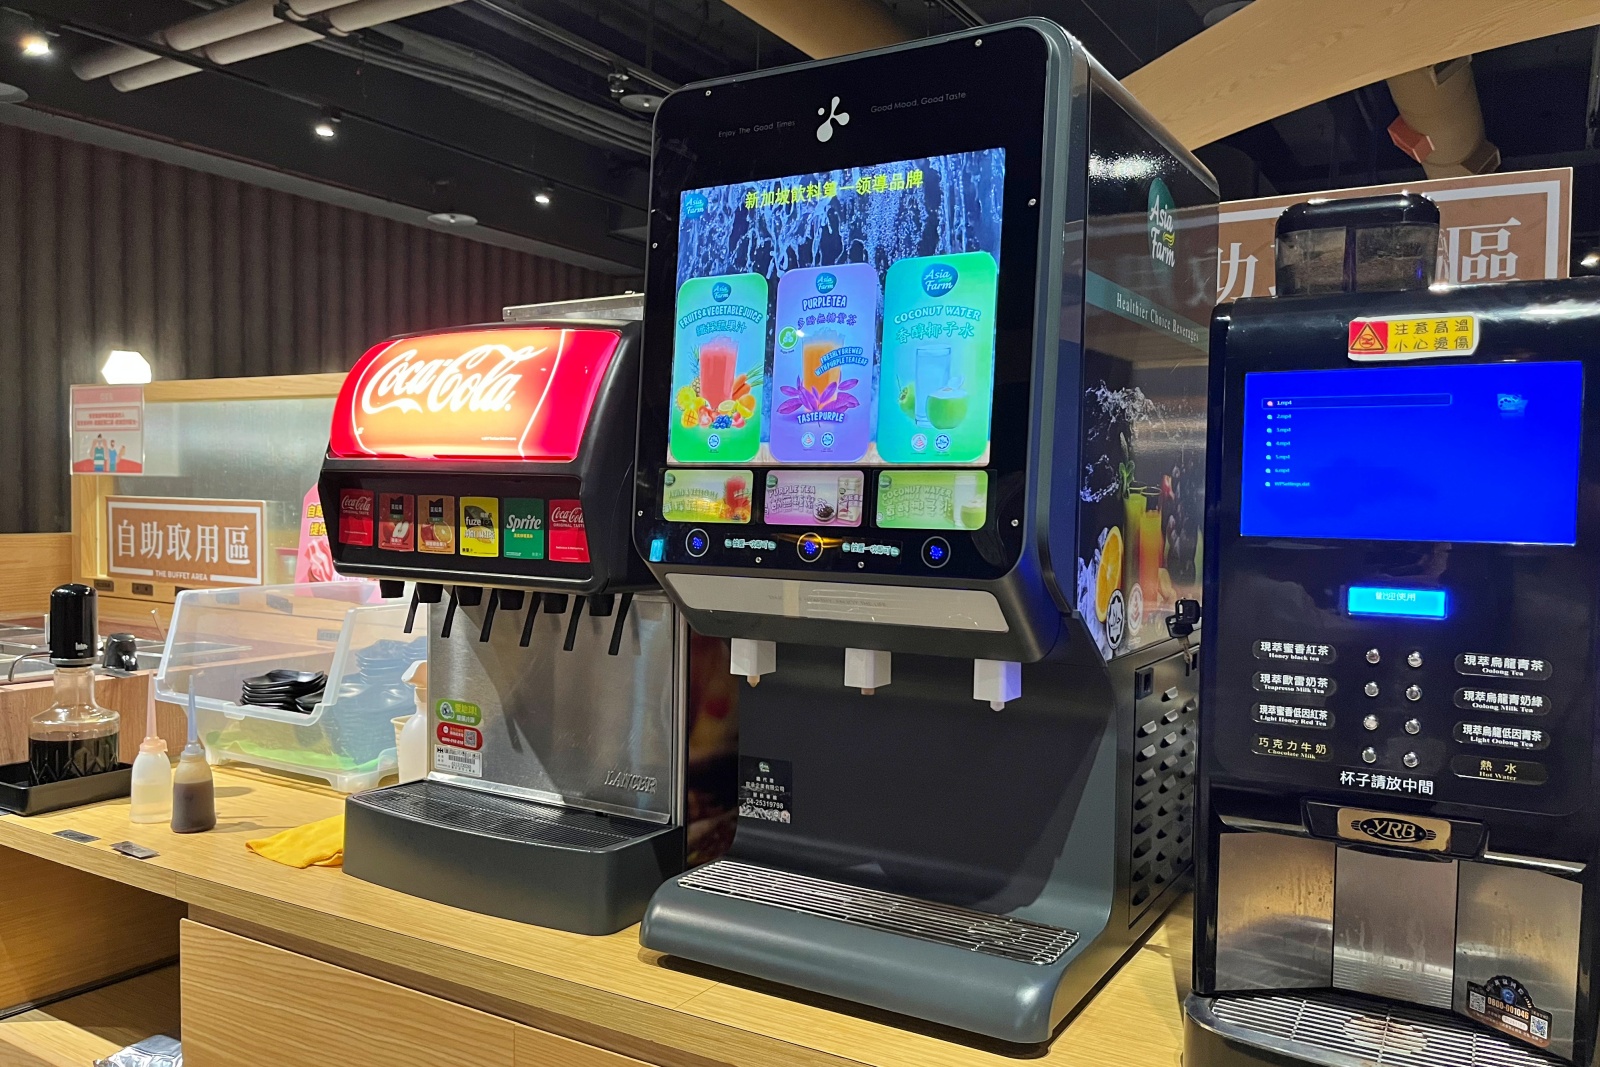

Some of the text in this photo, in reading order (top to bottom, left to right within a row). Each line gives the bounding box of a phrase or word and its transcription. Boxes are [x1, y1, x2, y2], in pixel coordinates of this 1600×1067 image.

[870, 102, 892, 113] Good
[921, 95, 944, 105] Good
[945, 92, 966, 100] Taste
[718, 130, 736, 138] Enjoy
[753, 123, 774, 132] Good
[776, 120, 795, 129] Times
[686, 198, 703, 206] Asia
[687, 206, 704, 214] Farm
[1150, 194, 1174, 232] Asia
[1151, 227, 1175, 267] Farm
[924, 268, 950, 280] Asia
[925, 280, 953, 292] Farm
[802, 295, 847, 311] PURPLE TEA
[680, 309, 702, 329] FRUITS
[707, 305, 744, 317] VEGETABLE
[743, 307, 763, 323] JUICE
[894, 305, 981, 325] COCONUT WATER
[1116, 292, 1199, 343] Healthier Choice Beverages
[1395, 319, 1469, 335] 注意高溫
[1394, 336, 1469, 352] 小心燙傷
[820, 347, 863, 363] FRESHLY BREWED
[362, 344, 548, 415] Coca-Cola
[797, 411, 845, 424] TASTE PURPLE
[769, 485, 816, 498] PURPLE TEA
[882, 486, 952, 501] COCONUT WATER
[342, 495, 372, 512] Coca-Cola
[466, 516, 481, 526] fuze
[506, 514, 541, 532] Sprite
[118, 519, 250, 564] 自助取用區
[168, 571, 190, 580] BUFFET
[1260, 641, 1329, 656] 現萃蜜香紅茶
[1464, 655, 1544, 672] 現萃烏龍青茶
[1482, 668, 1509, 676] Oolong
[1463, 690, 1543, 708] 現萃烏龍青奶綠
[1472, 703, 1499, 711] Oolong
[1259, 704, 1328, 721] 現萃蜜香低因紅茶
[1278, 716, 1299, 724] Honey
[1463, 724, 1542, 742] 現萃烏龍低因青茶
[1470, 736, 1490, 744] Light
[1492, 738, 1518, 747] Oolong
[1259, 738, 1327, 755] 巧克力牛奶
[1267, 749, 1299, 757] Chocolate
[604, 770, 657, 794] LANCER
[1340, 770, 1434, 795] 杯子請放中間
[1367, 819, 1416, 839] YRB
[1488, 997, 1529, 1020] 0800-001046
